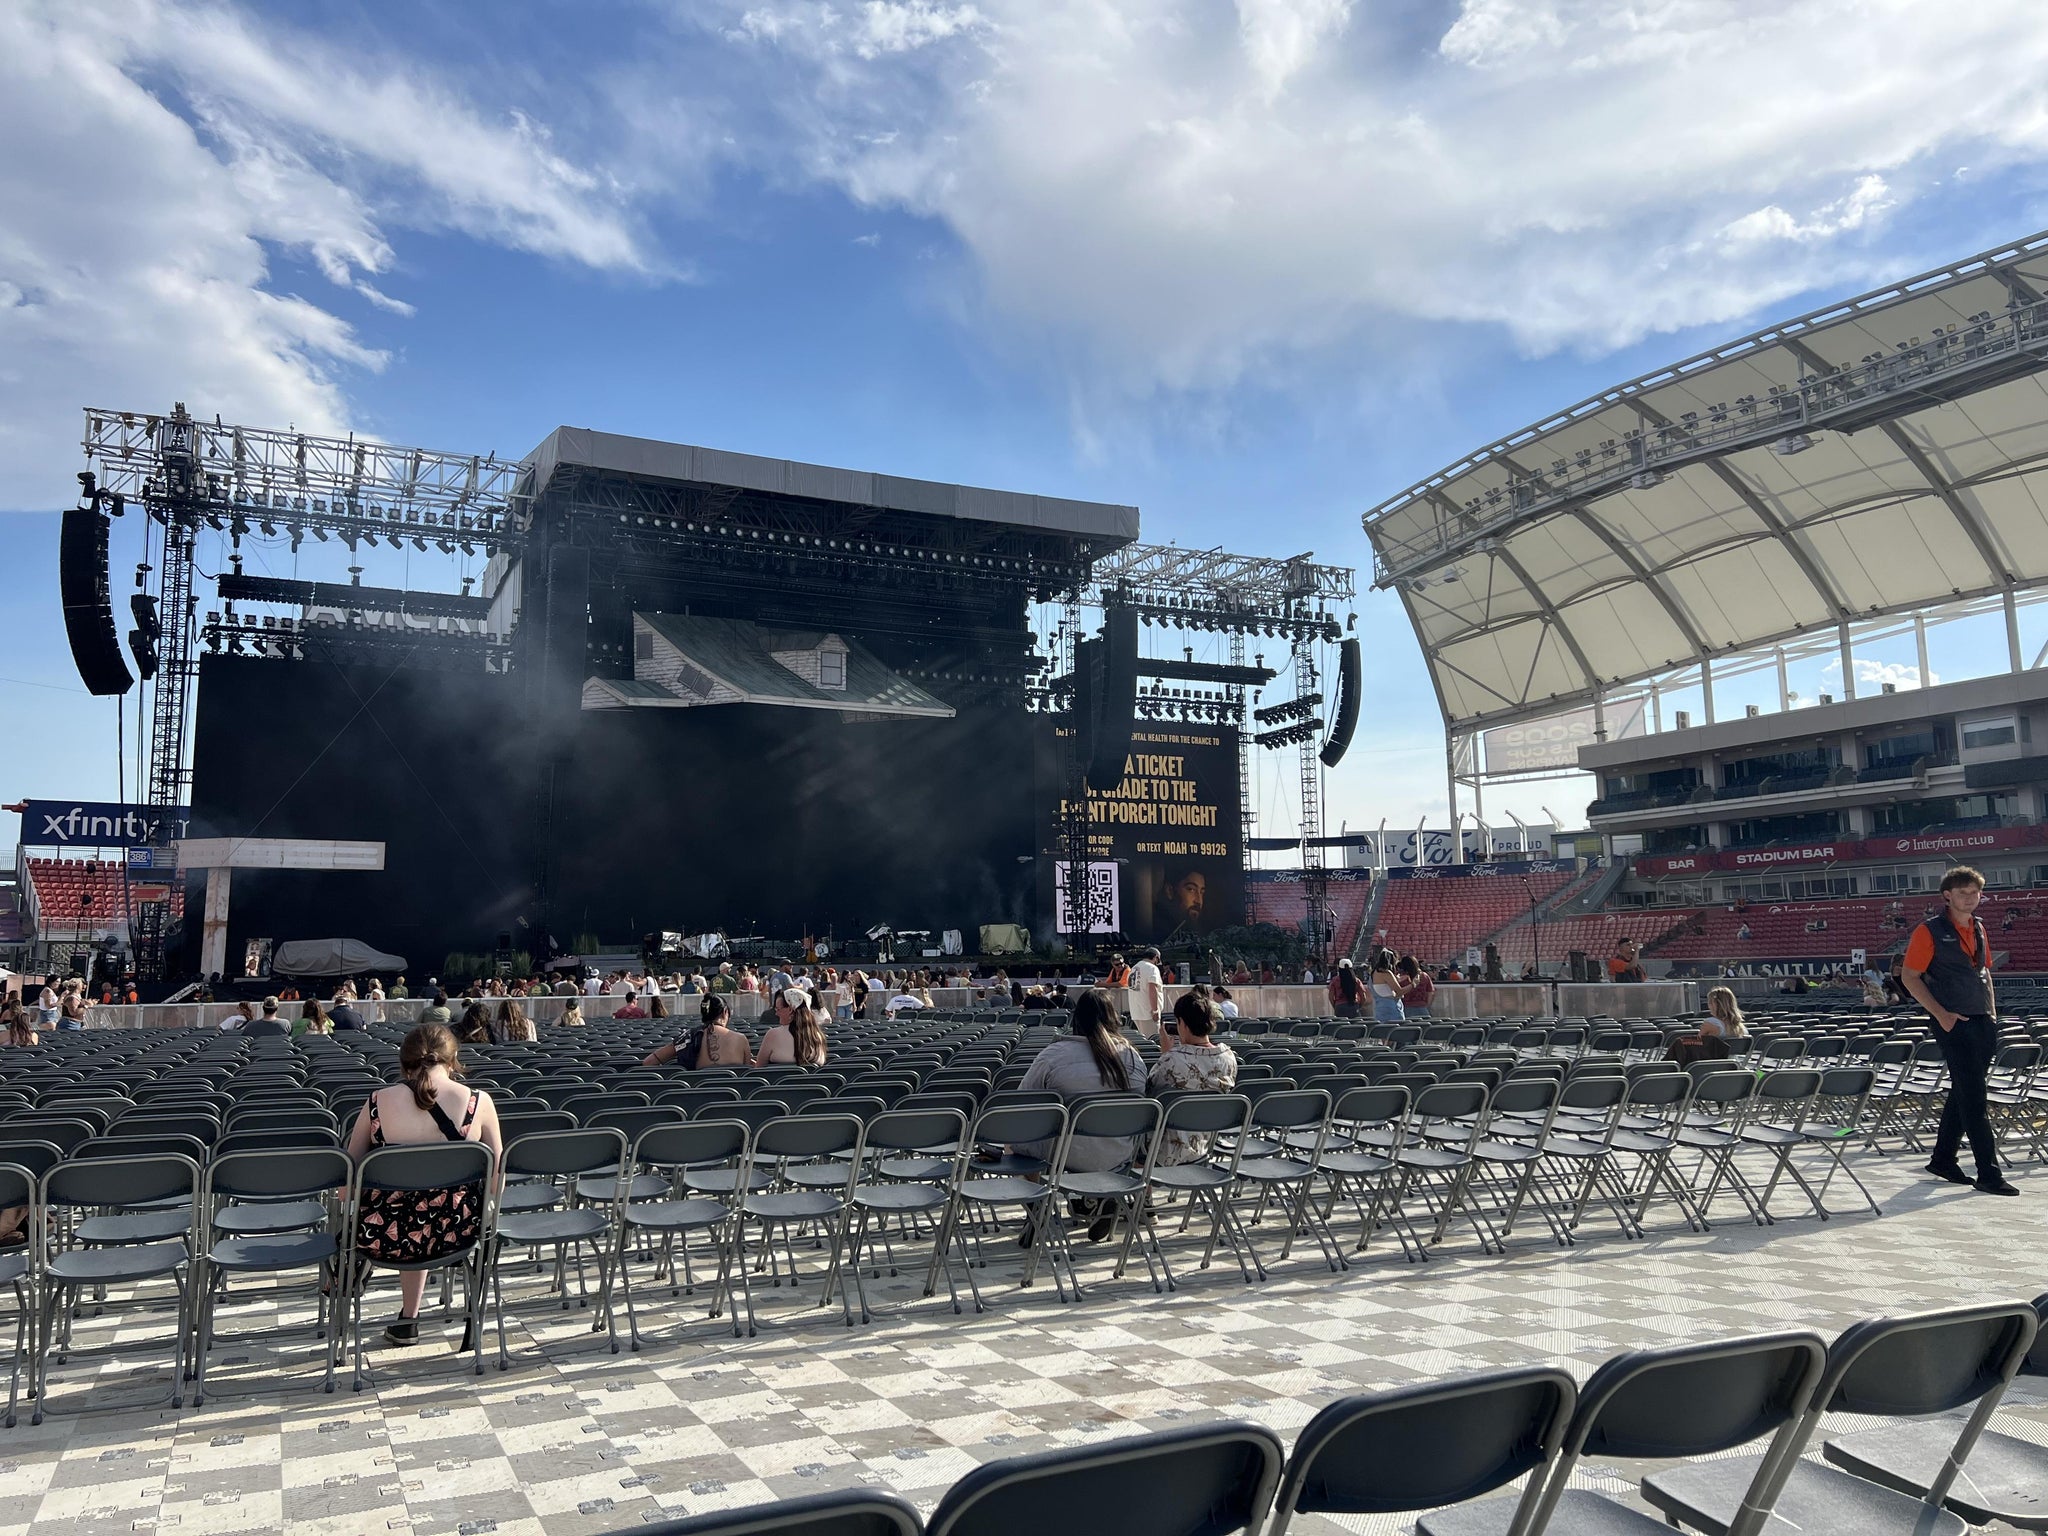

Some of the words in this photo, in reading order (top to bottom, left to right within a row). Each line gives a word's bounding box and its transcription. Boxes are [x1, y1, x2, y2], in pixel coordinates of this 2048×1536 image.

[1148, 733, 1168, 743] HEALTH
[1169, 734, 1180, 744] FOR
[1180, 735, 1191, 744] THE
[1191, 736, 1212, 746] CHANCE
[1212, 738, 1220, 746] TO
[1124, 753, 1135, 775] A
[1136, 754, 1184, 777] TICKET
[1151, 779, 1169, 801] TO
[1171, 780, 1197, 802] THE
[1109, 802, 1157, 825] PORCH
[1159, 803, 1217, 827] TONIGHT
[42, 807, 160, 843] xfinity
[1137, 842, 1146, 852] OR
[1146, 843, 1161, 853] TEXT
[1164, 841, 1187, 854] NOAH
[1190, 844, 1198, 854] TO
[1200, 842, 1227, 856] 99126
[1498, 840, 1542, 851] PROUD
[1913, 836, 1964, 851] Interform
[1967, 835, 1994, 846] CLUB
[1736, 850, 1799, 864] STADIUM
[1802, 847, 1834, 859] BAR
[1471, 864, 1498, 877] Ford
[1530, 861, 1558, 874] Ford
[1668, 859, 1695, 870] BAR
[1274, 871, 1301, 882] Ford
[1332, 869, 1358, 881] Ford
[1412, 867, 1440, 879] Ford
[1761, 963, 1803, 977] SALT
[1808, 962, 1856, 976] LAKE
